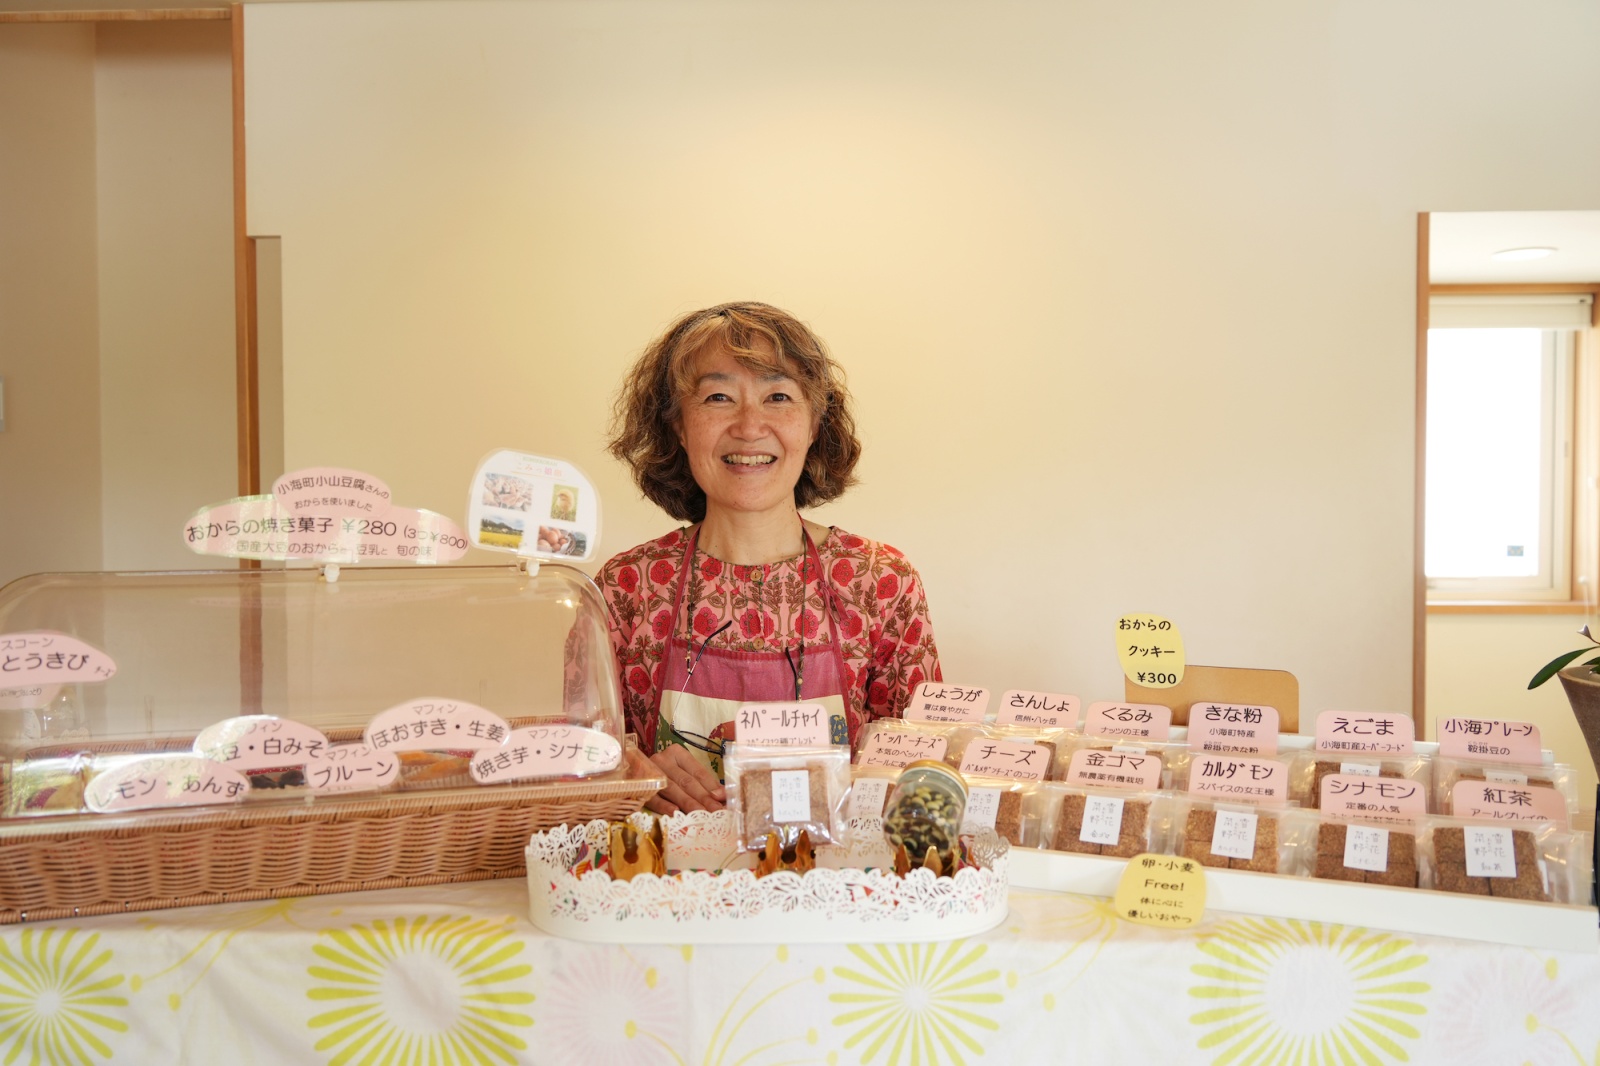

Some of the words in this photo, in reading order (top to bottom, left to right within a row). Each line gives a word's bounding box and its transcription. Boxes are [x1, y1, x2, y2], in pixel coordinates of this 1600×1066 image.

[277, 475, 390, 499] 小海町小山豆腐さんの
[294, 497, 373, 512] おからを使いました
[186, 517, 333, 542] おからの焼き菓子
[342, 518, 397, 537] ¥280
[356, 543, 388, 556] 豆乳と
[1119, 618, 1172, 631] おからの
[1, 637, 54, 651] スコーン
[1128, 645, 1176, 658] クッキー
[2, 652, 90, 672] とうきび
[1137, 671, 1177, 685] ¥300
[922, 684, 983, 702] しょうが
[413, 703, 458, 716] マフィン
[924, 703, 970, 715] 夏は爽やかに
[1010, 693, 1070, 712] さんしょ
[741, 708, 820, 730] ネパールチャイ
[1101, 706, 1153, 723] くるみ
[1205, 705, 1262, 724] きな粉
[371, 718, 505, 749] ほおずき・生姜
[528, 728, 572, 740] マフィン
[1100, 726, 1150, 737] ナッツの王様
[1209, 727, 1256, 738] 小海町特産
[1332, 717, 1394, 735] えごま
[1445, 719, 1533, 737] 小海プレーン
[207, 737, 324, 761] 豆・白みそ
[873, 733, 942, 749] ペッパーチーズ
[325, 746, 371, 762] マフィン
[875, 747, 931, 758] 本気のペッパー
[980, 745, 1037, 765] チーズ
[867, 757, 912, 768] ビールにあ
[1085, 752, 1145, 770] 金ゴマ
[313, 761, 393, 788] プルーン
[1078, 771, 1145, 785] 無農薬有機栽培
[1202, 761, 1273, 780] カルダモン
[1197, 783, 1275, 797] スパイスの女王様
[1330, 780, 1416, 799] シナモン
[1483, 787, 1533, 807] 紅茶
[1345, 802, 1401, 814] 定番の人気
[1142, 858, 1194, 874] 卵・小麦
[1144, 879, 1184, 892] Free!
